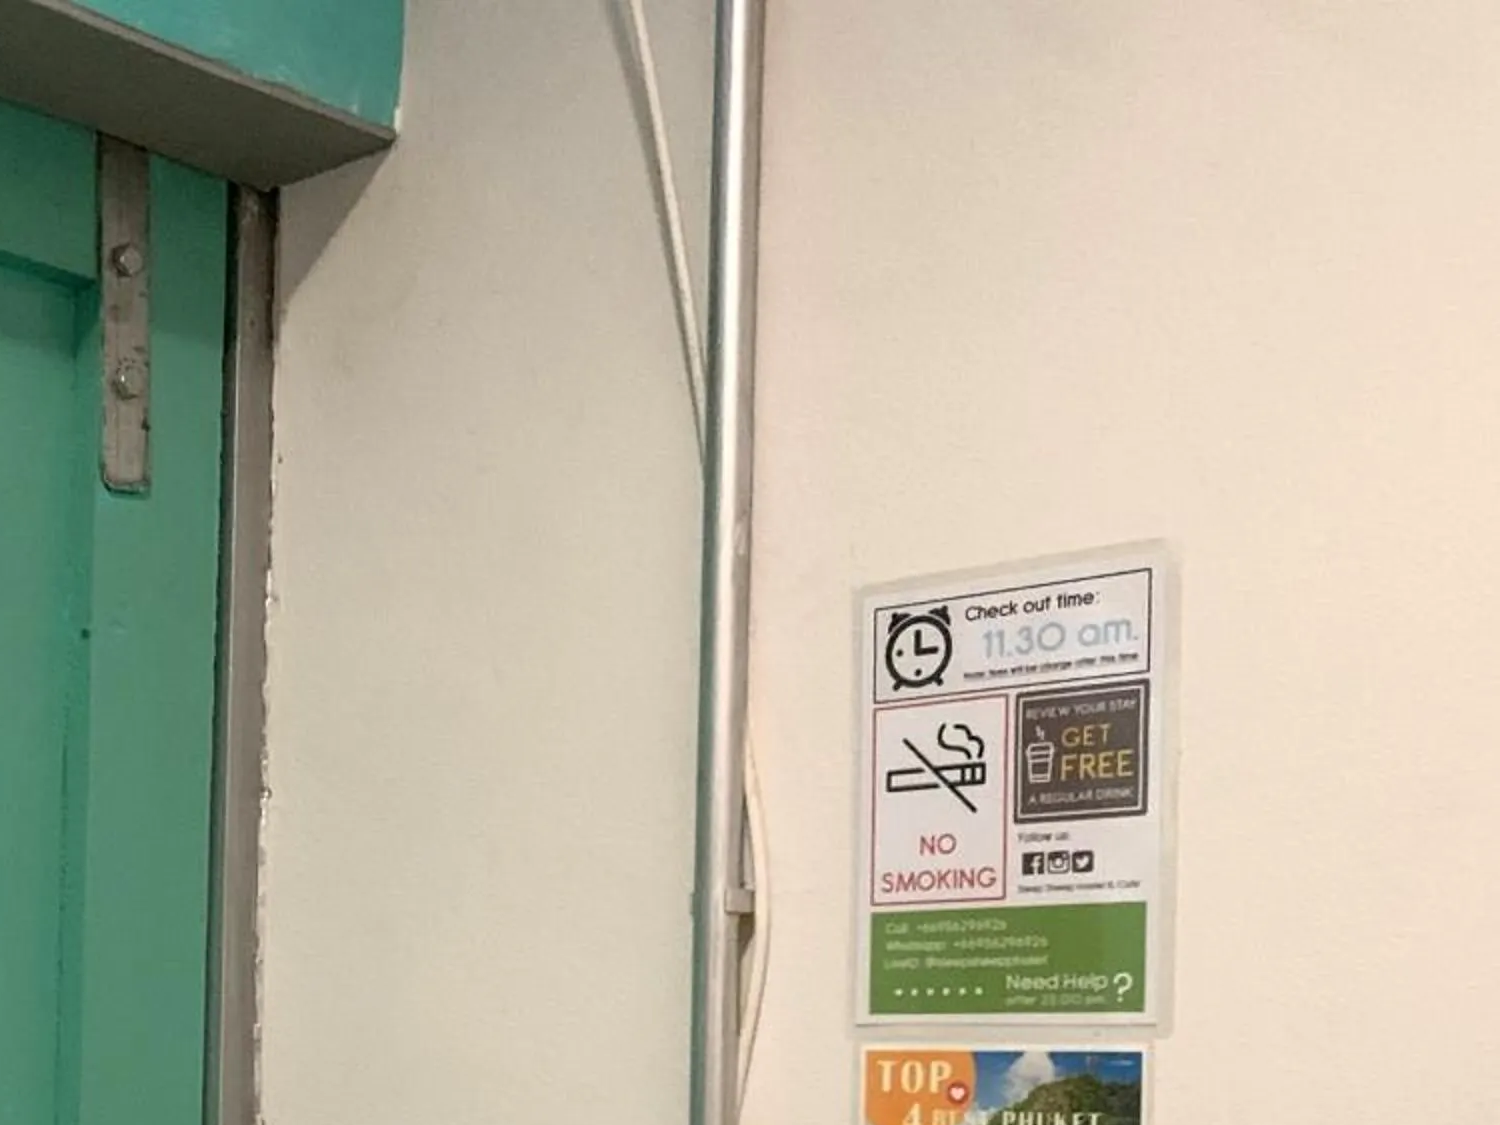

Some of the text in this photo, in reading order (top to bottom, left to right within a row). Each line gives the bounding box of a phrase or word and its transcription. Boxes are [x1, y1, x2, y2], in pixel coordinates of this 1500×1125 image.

[965, 591, 1101, 622] Check out time:
[983, 619, 1139, 658] 11.30 am.
[1061, 723, 1112, 748] GET
[1060, 749, 1134, 781] FREE
[919, 833, 957, 856] NO
[881, 866, 997, 894] SMOKING
[1006, 973, 1059, 990] Need
[1063, 972, 1109, 992] Help
[877, 1060, 953, 1094] TOP
